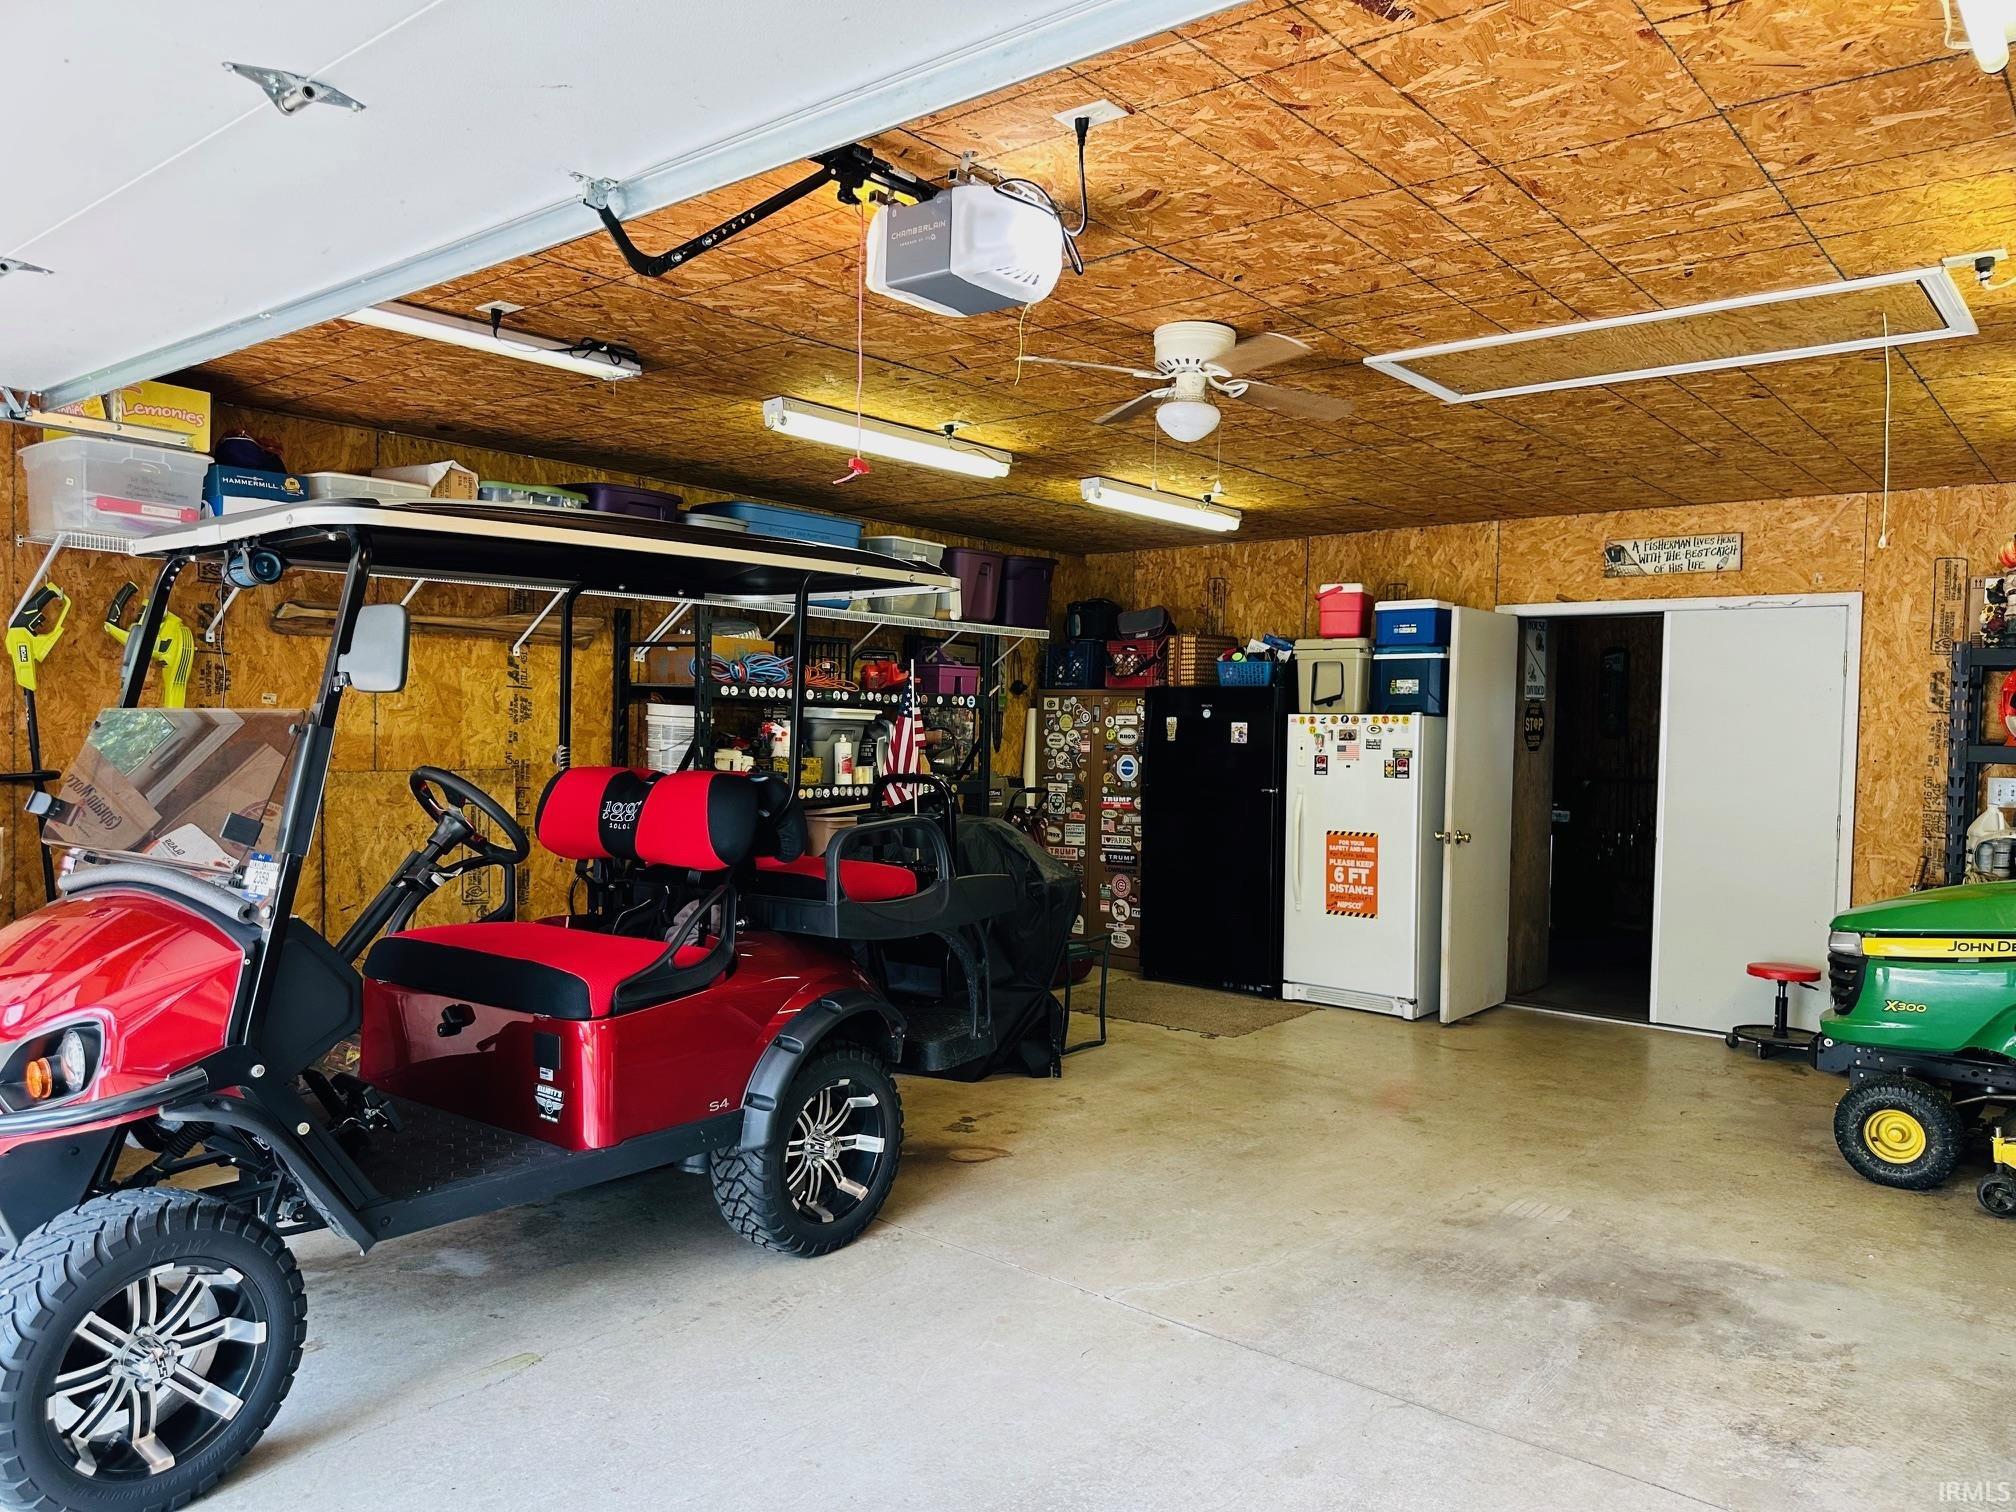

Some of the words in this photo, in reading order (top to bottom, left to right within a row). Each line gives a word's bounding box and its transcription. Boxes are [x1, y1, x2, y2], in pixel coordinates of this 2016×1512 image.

[891, 220, 946, 240] CHAMBERLAIN
[122, 400, 205, 427] Lemonies
[222, 477, 279, 490] HAMMERMILL
[1632, 541, 1640, 553] A
[1638, 552, 1661, 564] WITH
[1664, 550, 1681, 562] THE
[1685, 547, 1711, 559] BEST
[1711, 545, 1738, 557] CATCH
[1653, 565, 1665, 574] OF
[1668, 563, 1683, 573] HIS
[1525, 717, 1544, 732] STOP
[1329, 858, 1355, 867] PLEASE
[1334, 867, 1344, 883] 6
[1348, 868, 1370, 884] FT
[1329, 883, 1374, 895] DISTANCE
[1947, 940, 1994, 952] JOHN
[1884, 1000, 1927, 1013] X300
[709, 1097, 730, 1112] S4
